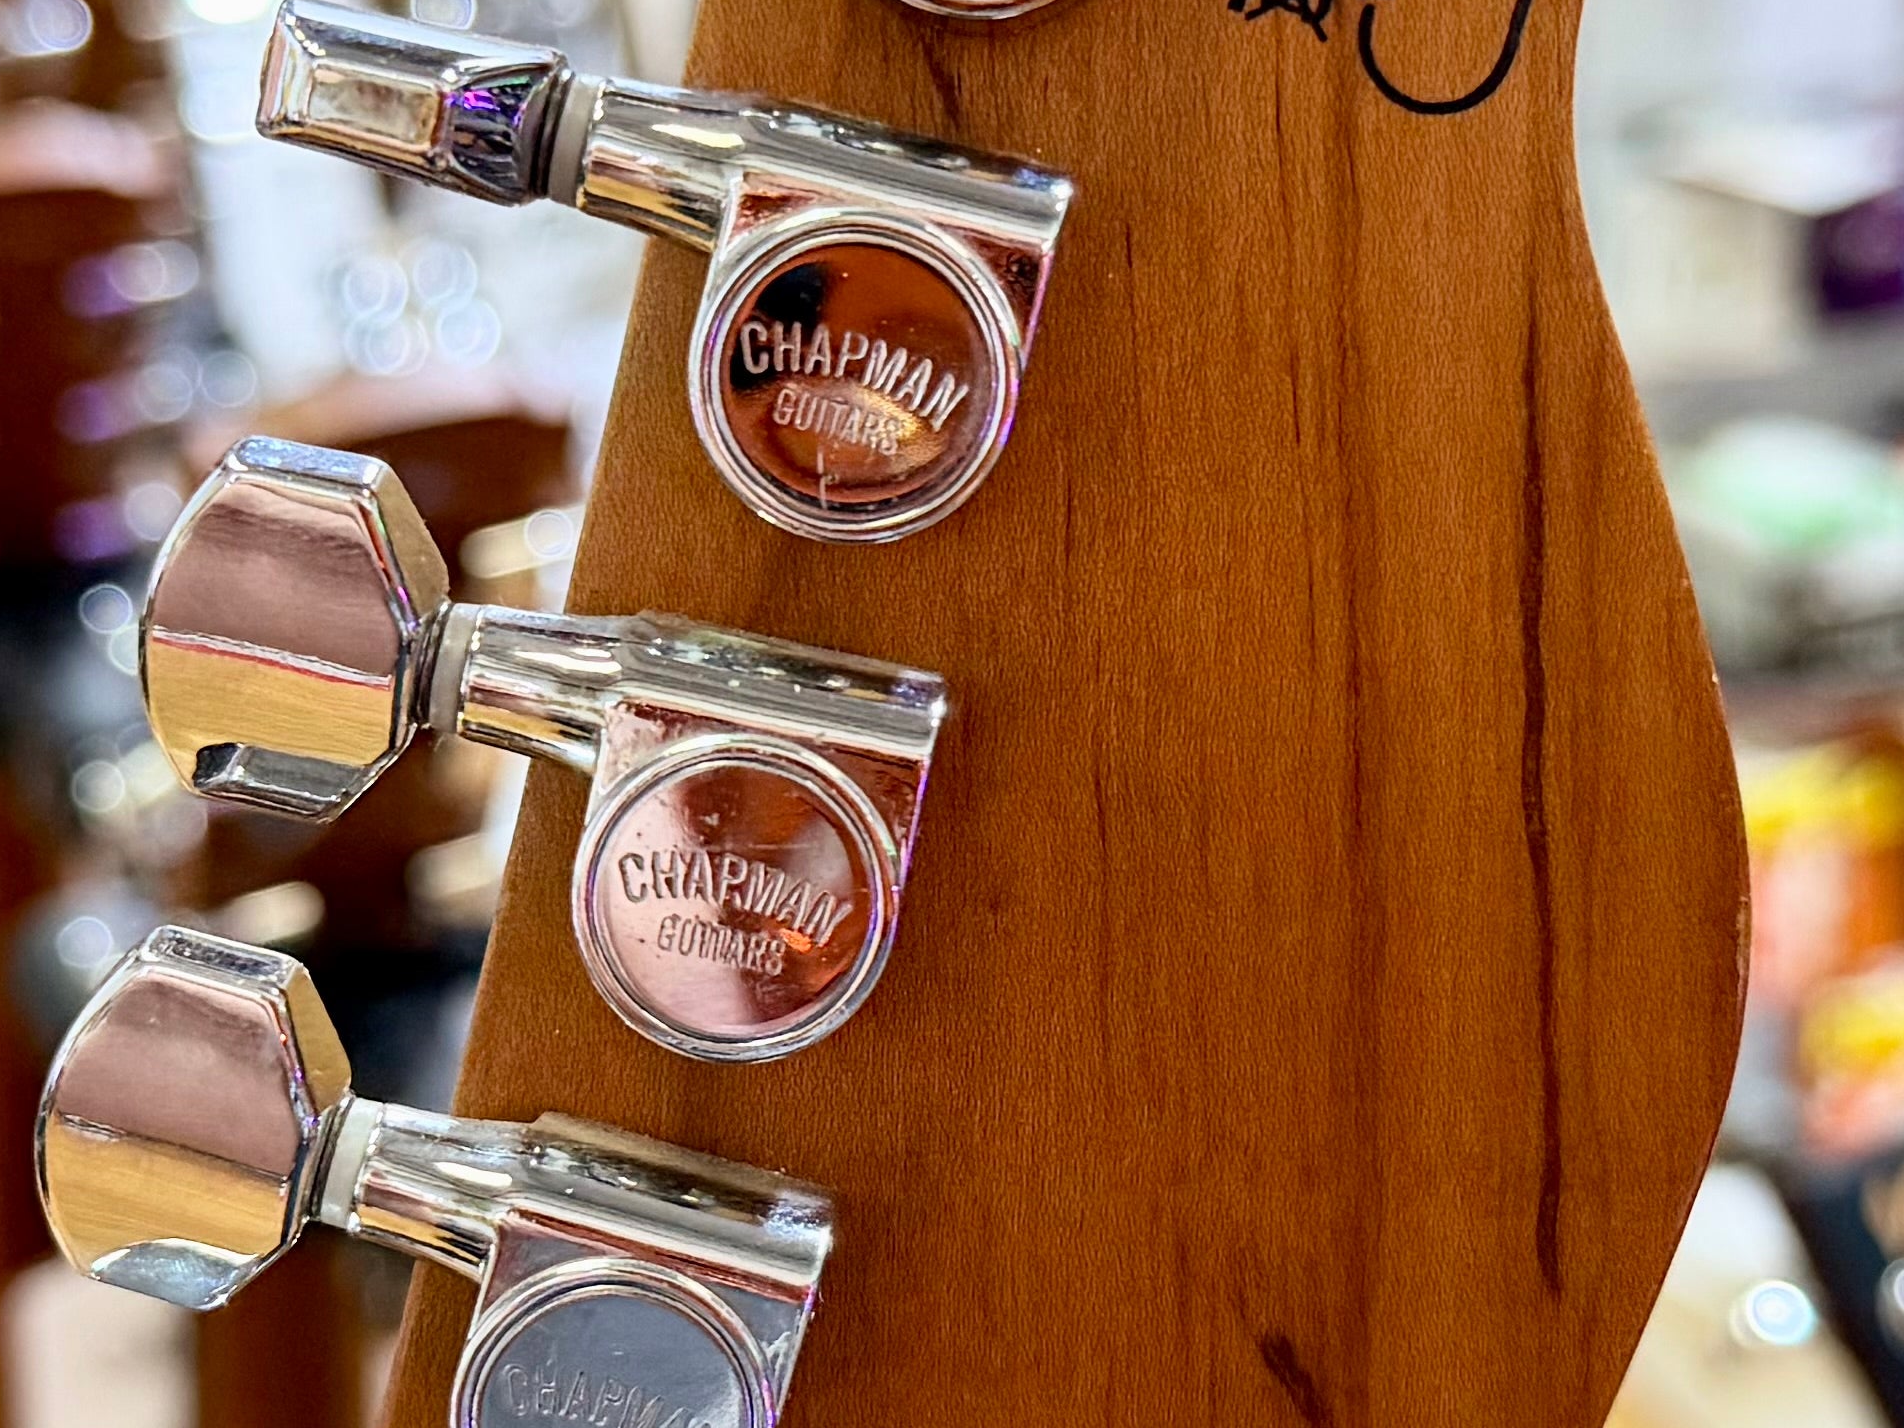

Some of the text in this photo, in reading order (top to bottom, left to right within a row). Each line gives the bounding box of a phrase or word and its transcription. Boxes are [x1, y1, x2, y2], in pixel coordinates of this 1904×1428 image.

[739, 320, 969, 432] CHAPMAN
[772, 386, 899, 456] GUITARS
[617, 848, 854, 948] CHAPMAN
[656, 913, 787, 977] GUITARS
